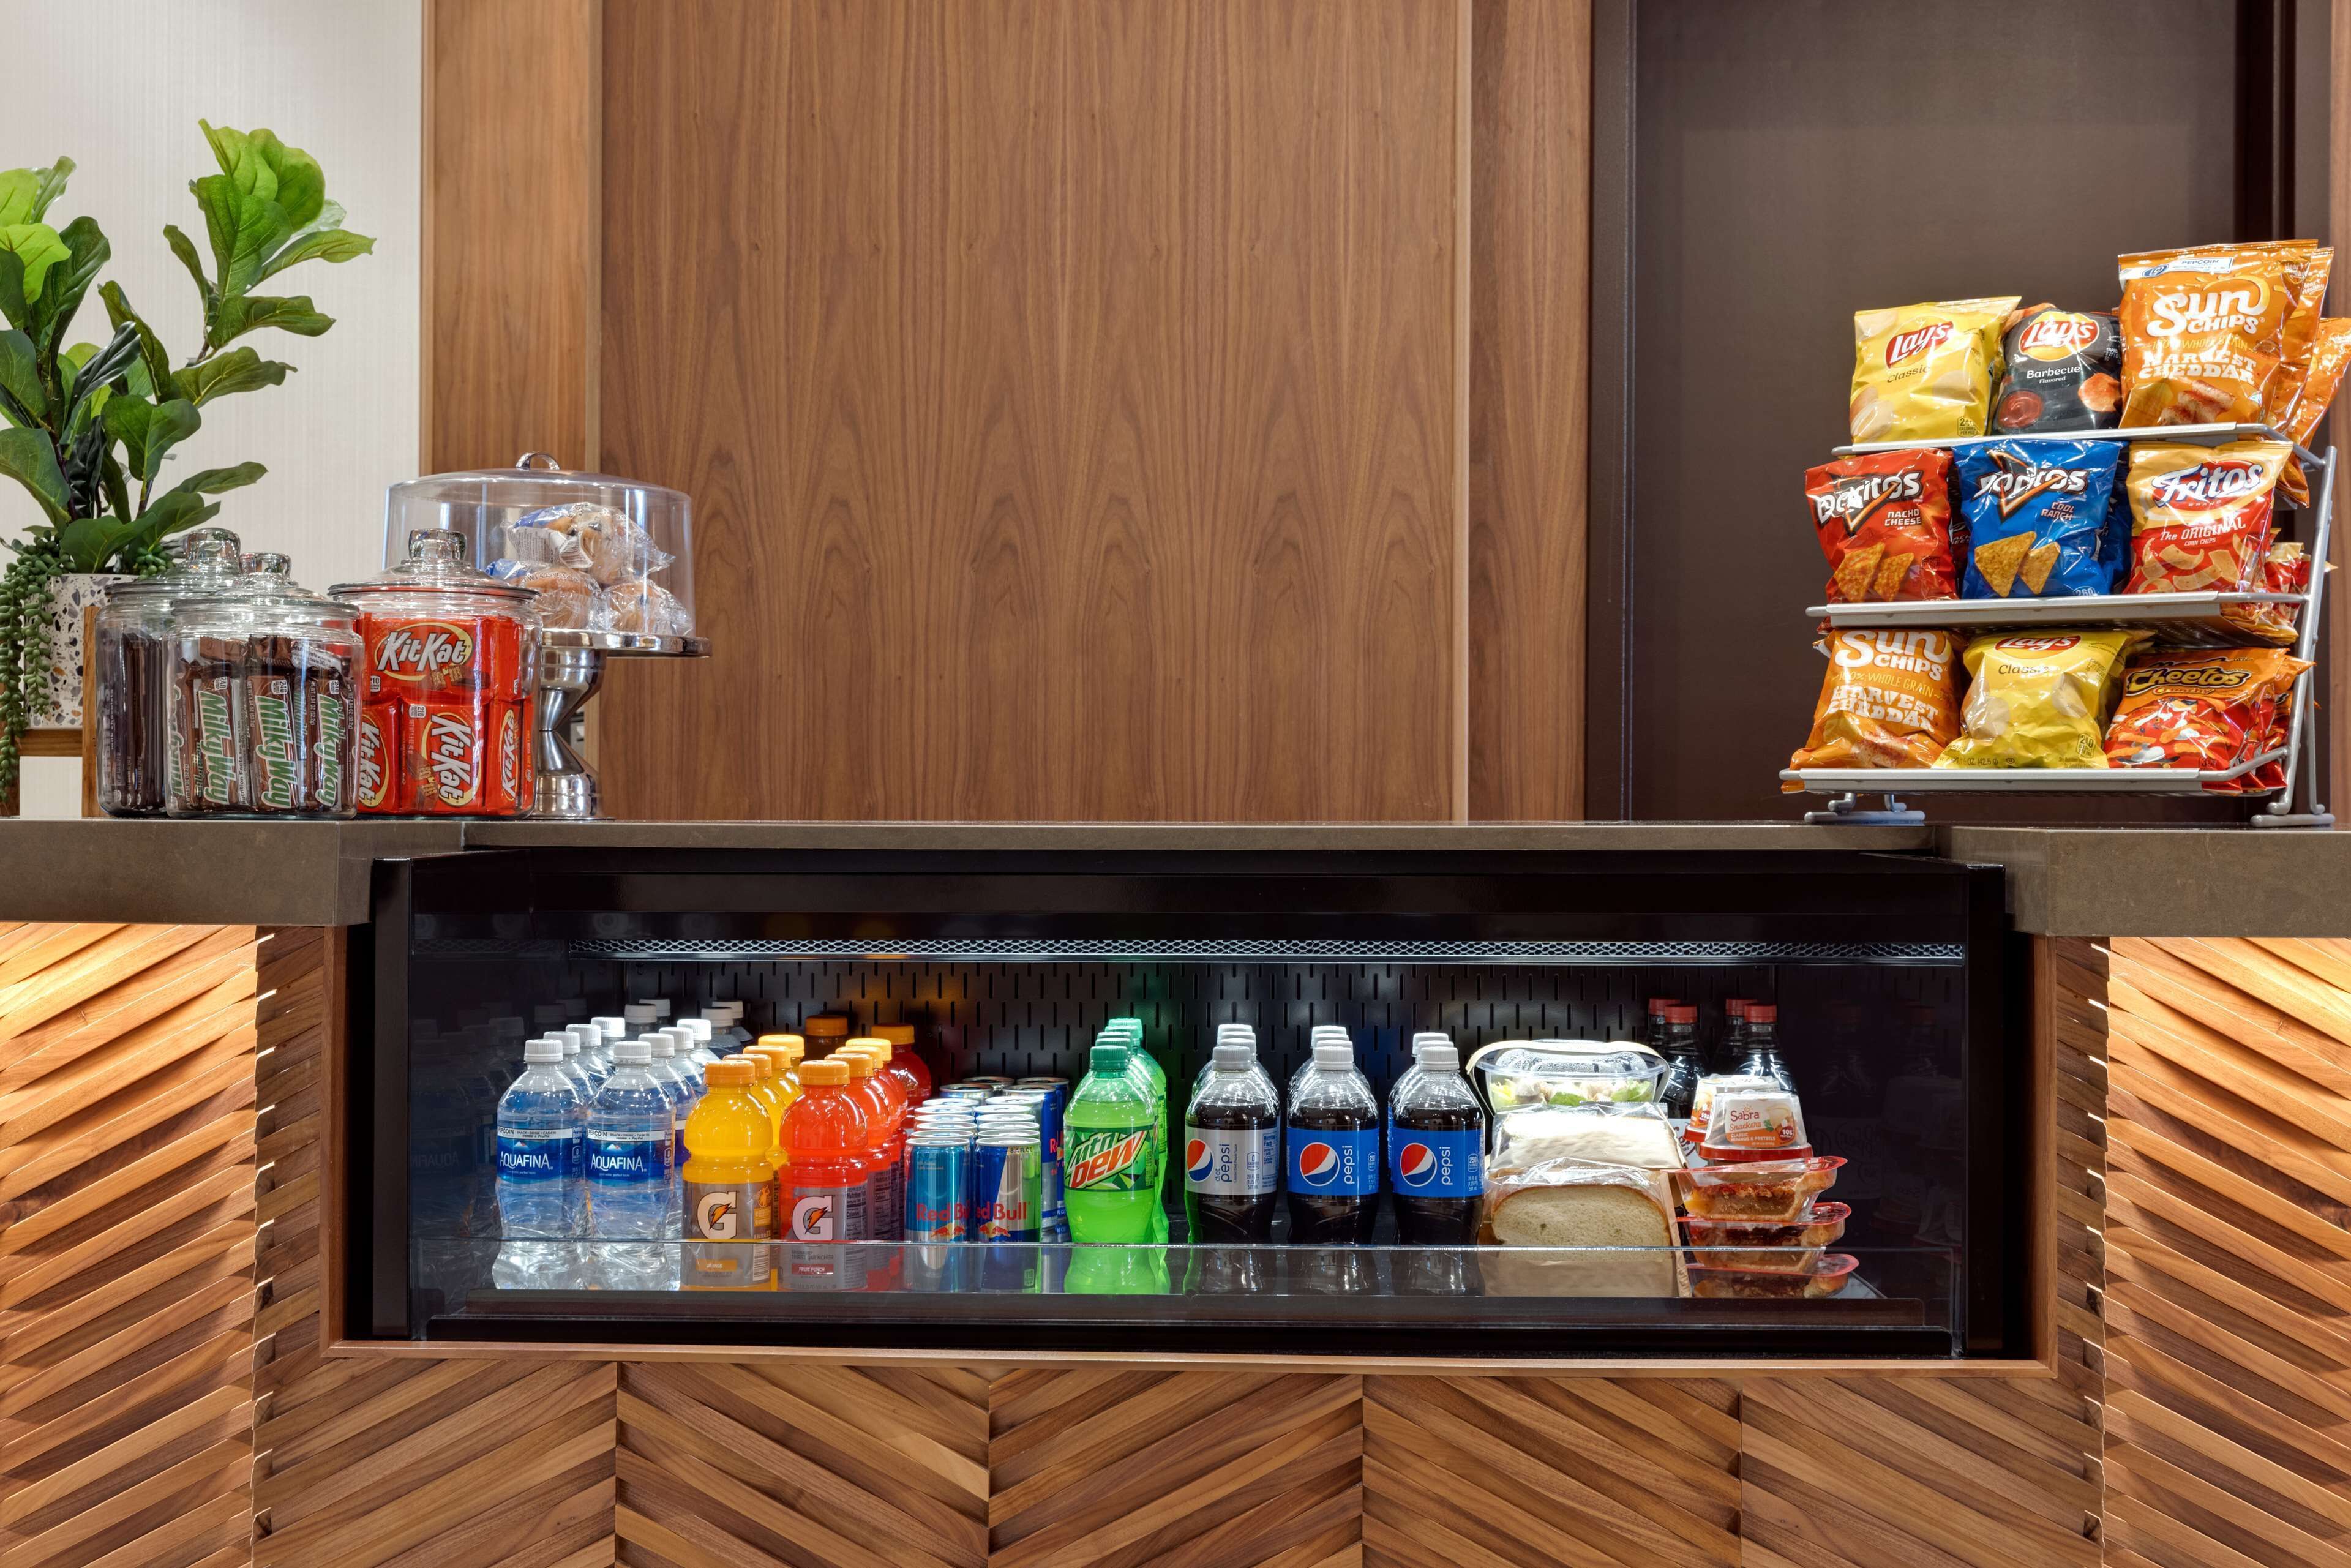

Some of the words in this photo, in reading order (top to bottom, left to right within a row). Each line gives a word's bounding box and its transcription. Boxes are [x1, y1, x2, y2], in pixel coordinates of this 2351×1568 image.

[2146, 276, 2270, 337] Sun
[2024, 320, 2094, 348] Lay's
[2188, 314, 2258, 334] CHIPS
[1889, 323, 1951, 364] Lay's
[1886, 365, 1930, 383] Classic
[2026, 366, 2081, 379] Barbecue
[2139, 364, 2255, 384] CHEDDAR
[1816, 472, 1921, 525] Doritos
[1973, 468, 2088, 502] Doritos
[2151, 463, 2263, 508] Fritos
[1888, 509, 1920, 519] NACHO
[2041, 508, 2074, 520] RANCH
[2051, 501, 2075, 513] COOL
[1884, 517, 1922, 527] CHEESE
[2160, 531, 2178, 541] The
[2181, 512, 2246, 540] ORIGINAL
[1835, 630, 1951, 667] Sun
[1998, 636, 2077, 651] Lay's
[1873, 654, 1943, 681] CHIPS
[1868, 673, 1902, 687] WHOLE
[1903, 678, 1933, 698] GRAIN
[2126, 667, 2252, 696] Cheetos
[1828, 698, 1935, 733] CHEDDAR
[1832, 685, 1938, 719] HARVEST
[1729, 1121, 1762, 1132] Snackers
[1730, 1110, 1760, 1122] Sabra
[500, 1150, 550, 1171] AQUAFINA
[591, 1153, 643, 1172] AQUAFINA
[1070, 1133, 1115, 1169] Mtn
[1219, 1144, 1233, 1182] pepsi
[1341, 1146, 1355, 1184] pepsi
[1439, 1146, 1453, 1185] pepsi
[696, 1190, 738, 1240] G
[792, 1195, 833, 1241] G
[916, 1201, 951, 1221] Red
[975, 1201, 991, 1221] ed
[993, 1201, 1027, 1221] Bull
